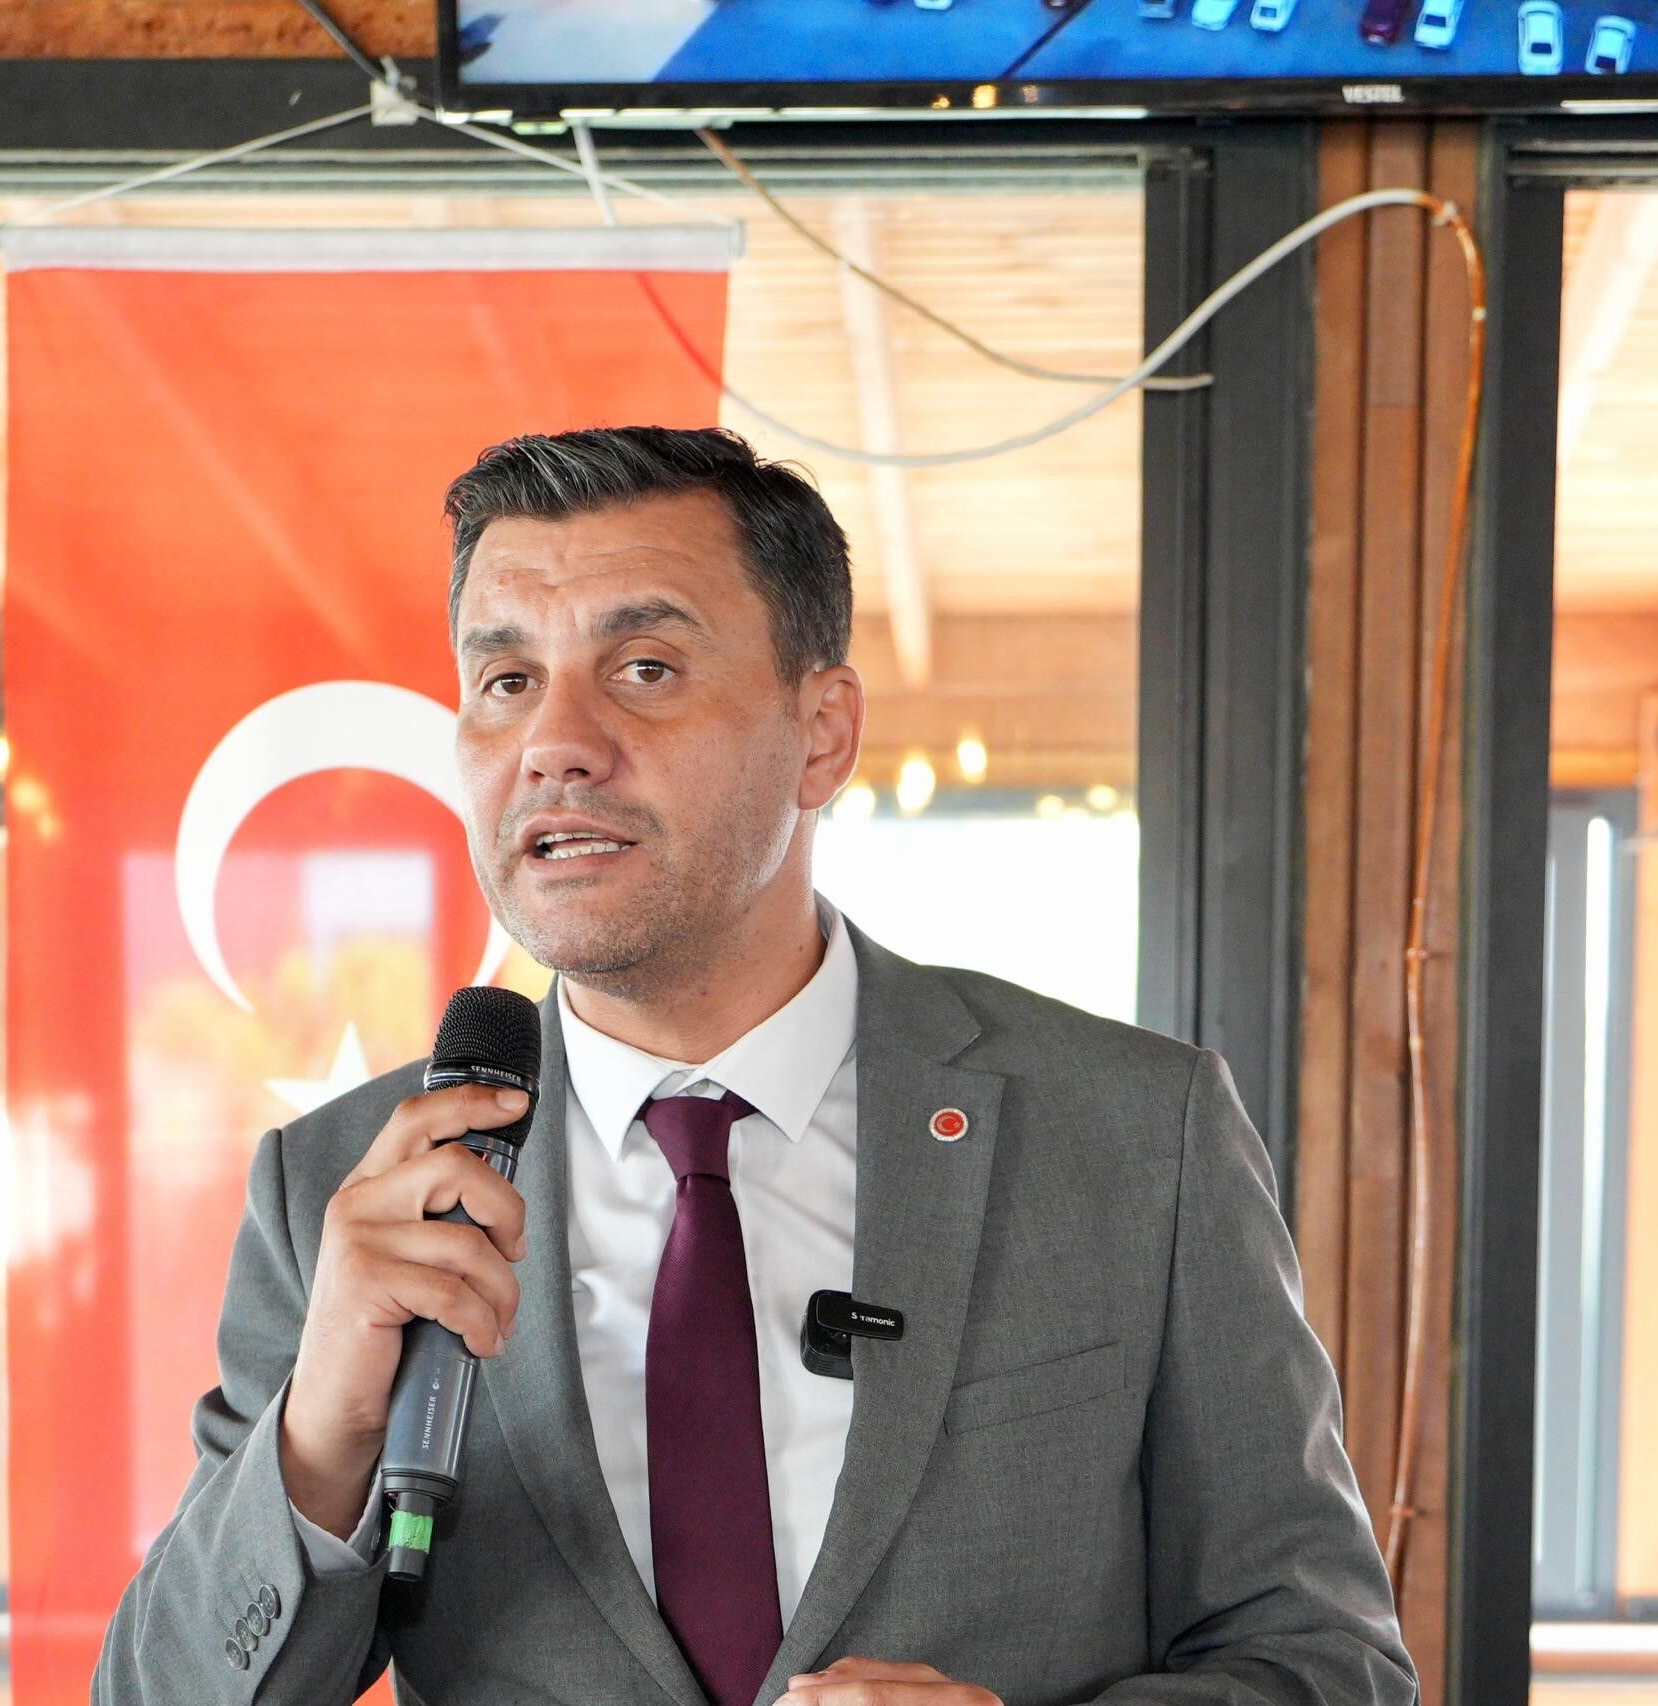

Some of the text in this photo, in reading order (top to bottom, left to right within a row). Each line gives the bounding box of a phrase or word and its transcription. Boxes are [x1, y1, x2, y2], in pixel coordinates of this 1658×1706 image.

[470, 1065, 521, 1082] SENNHEISER
[851, 1311, 896, 1327] Sramonic
[422, 1396, 437, 1450] SENNHEISER
